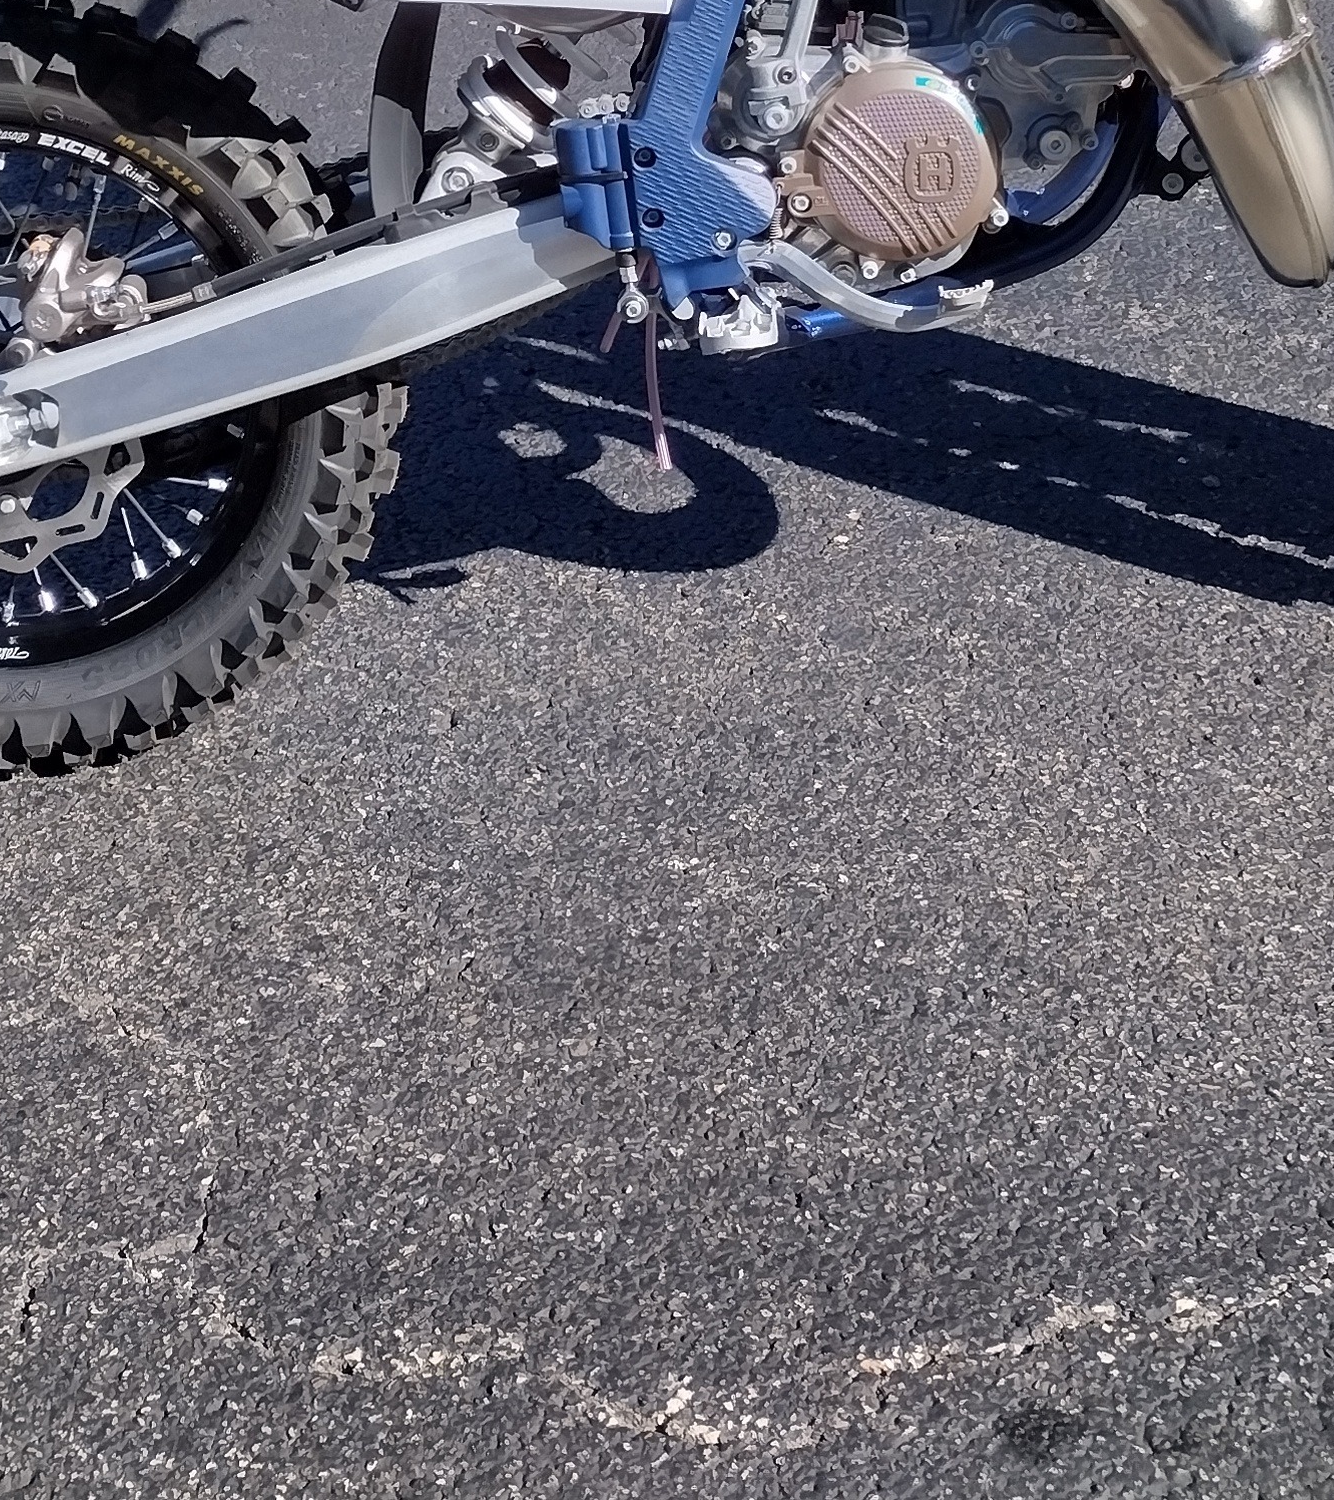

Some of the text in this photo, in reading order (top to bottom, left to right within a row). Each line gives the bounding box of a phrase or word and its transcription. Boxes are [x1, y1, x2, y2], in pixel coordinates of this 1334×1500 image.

[37, 132, 111, 166] EXCEL
[120, 163, 160, 193] Rim
[113, 134, 204, 196] MAXXIS
